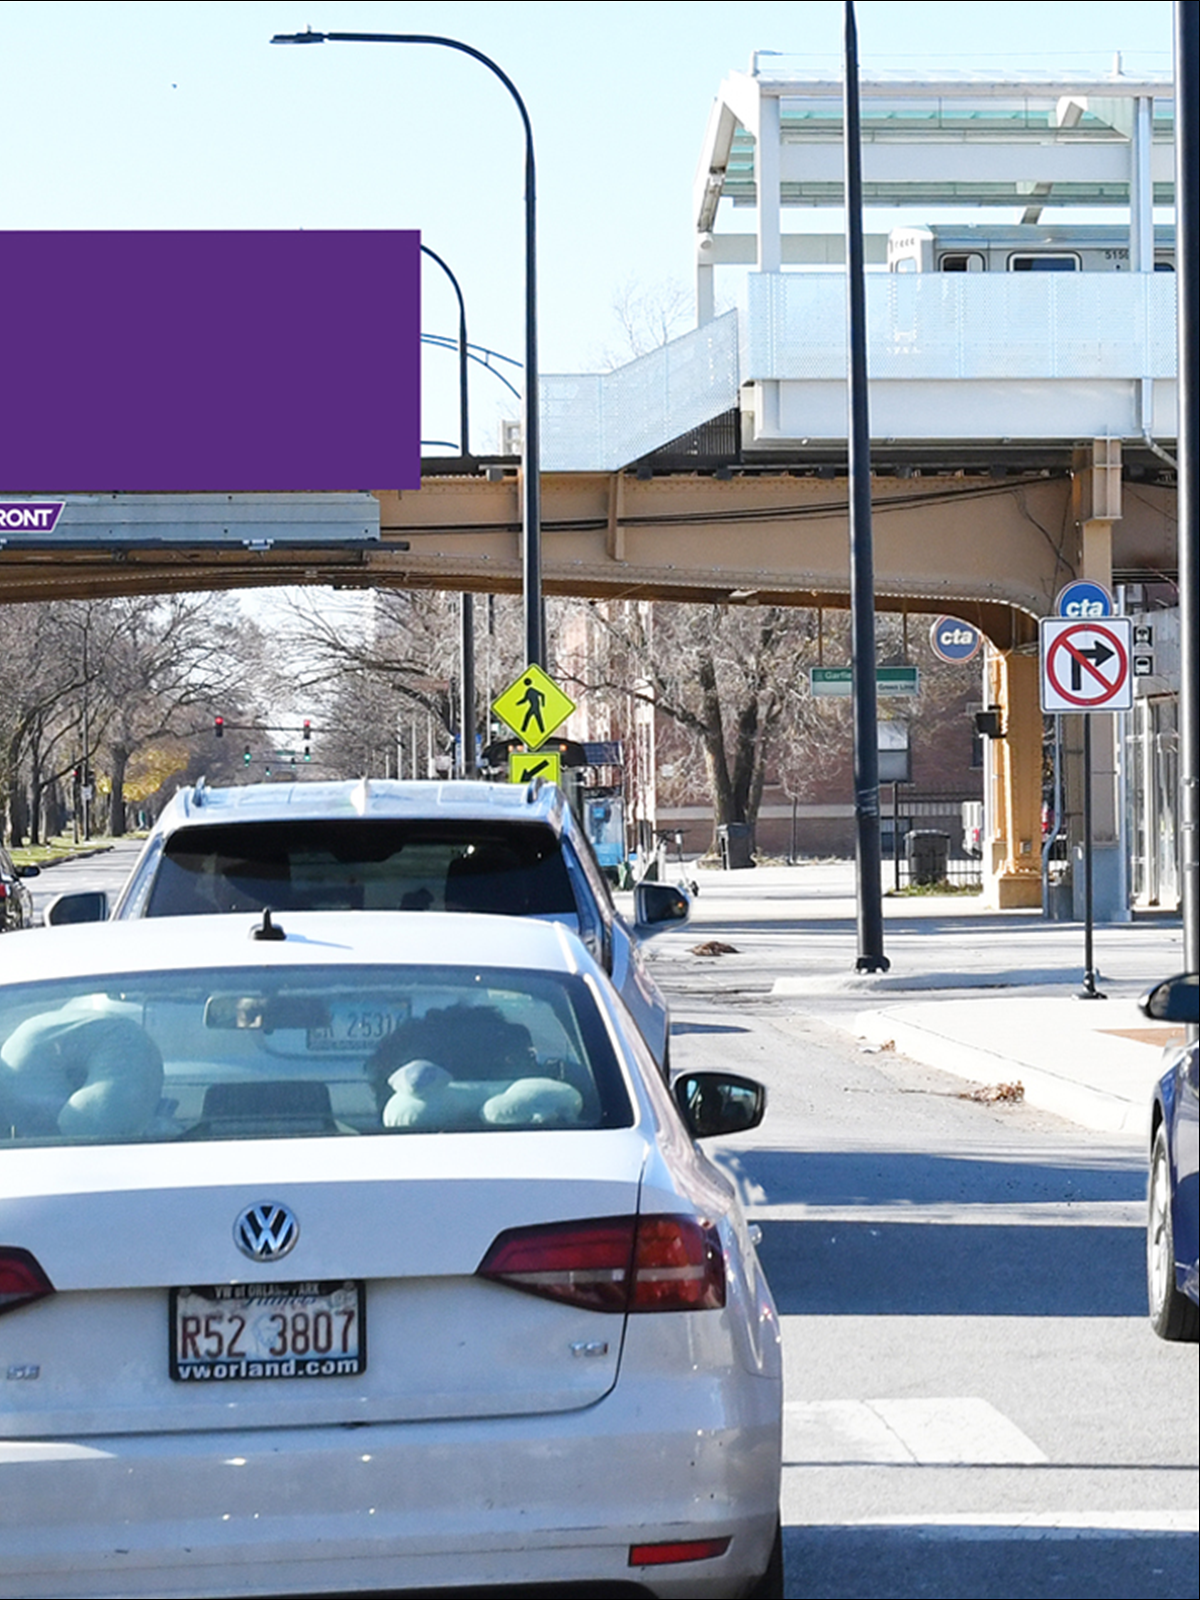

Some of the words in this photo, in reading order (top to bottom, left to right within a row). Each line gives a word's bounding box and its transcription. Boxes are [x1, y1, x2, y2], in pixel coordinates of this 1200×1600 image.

[1065, 598, 1104, 617] cta
[940, 628, 974, 645] cta
[824, 670, 853, 680] Garfie
[180, 1314, 246, 1360] R52
[269, 1310, 355, 1357] 3807
[178, 1358, 359, 1380] vworland.com
